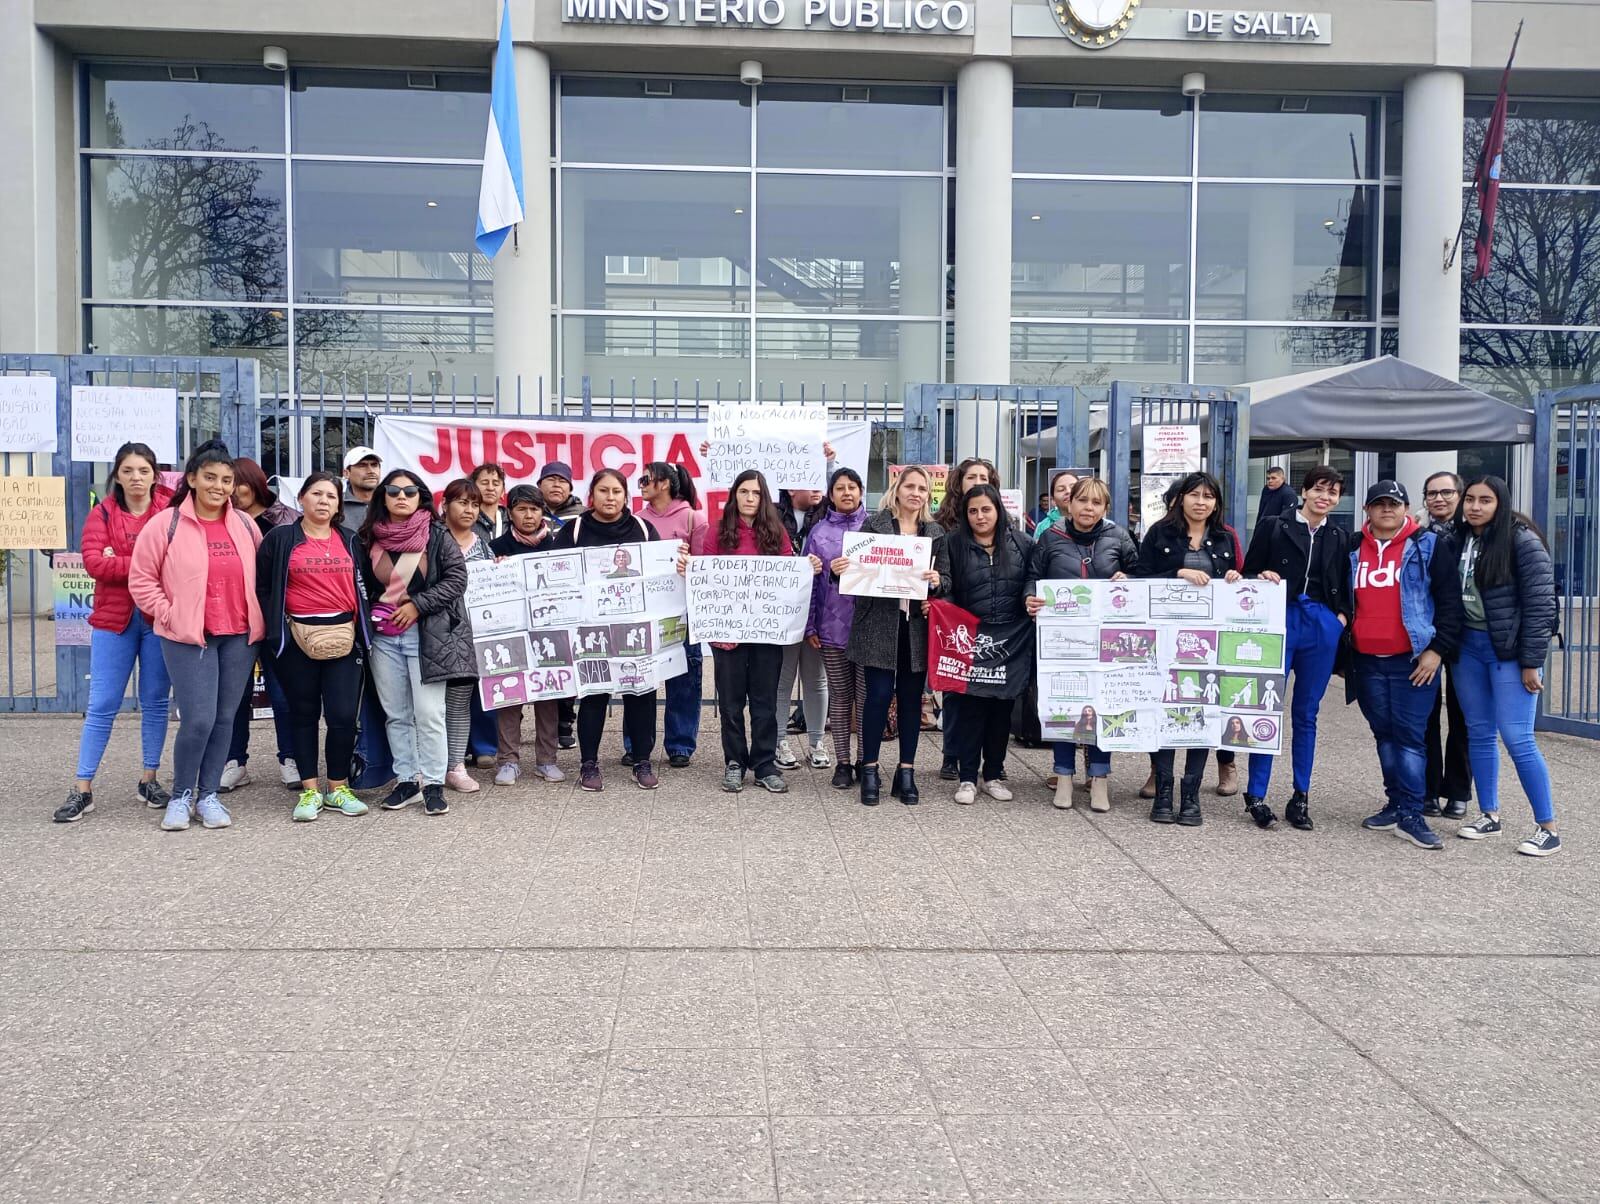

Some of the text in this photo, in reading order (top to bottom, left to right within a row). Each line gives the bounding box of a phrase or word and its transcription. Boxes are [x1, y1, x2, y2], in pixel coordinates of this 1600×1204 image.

[567, 0, 969, 30] MINISTERIO PUBLICO
[1187, 10, 1320, 37] DE SALTA
[710, 442, 809, 457] SOMOS LAS QUE
[419, 428, 702, 484] JUSTICIA
[871, 546, 904, 557] SENTENCIA
[305, 557, 341, 566] FPDS
[691, 558, 801, 573] EL PODER JUDICIAL
[859, 555, 914, 567] EJEMPLIFICADORA
[690, 574, 708, 586] CON
[713, 574, 729, 586] SU
[600, 584, 632, 595] ABUSO
[755, 591, 777, 601] NOS
[695, 604, 802, 616] EMPUJA AL SUICIDIO
[745, 618, 779, 629] LOCAS
[939, 655, 967, 669] FRENTE
[528, 669, 572, 693] SAP
